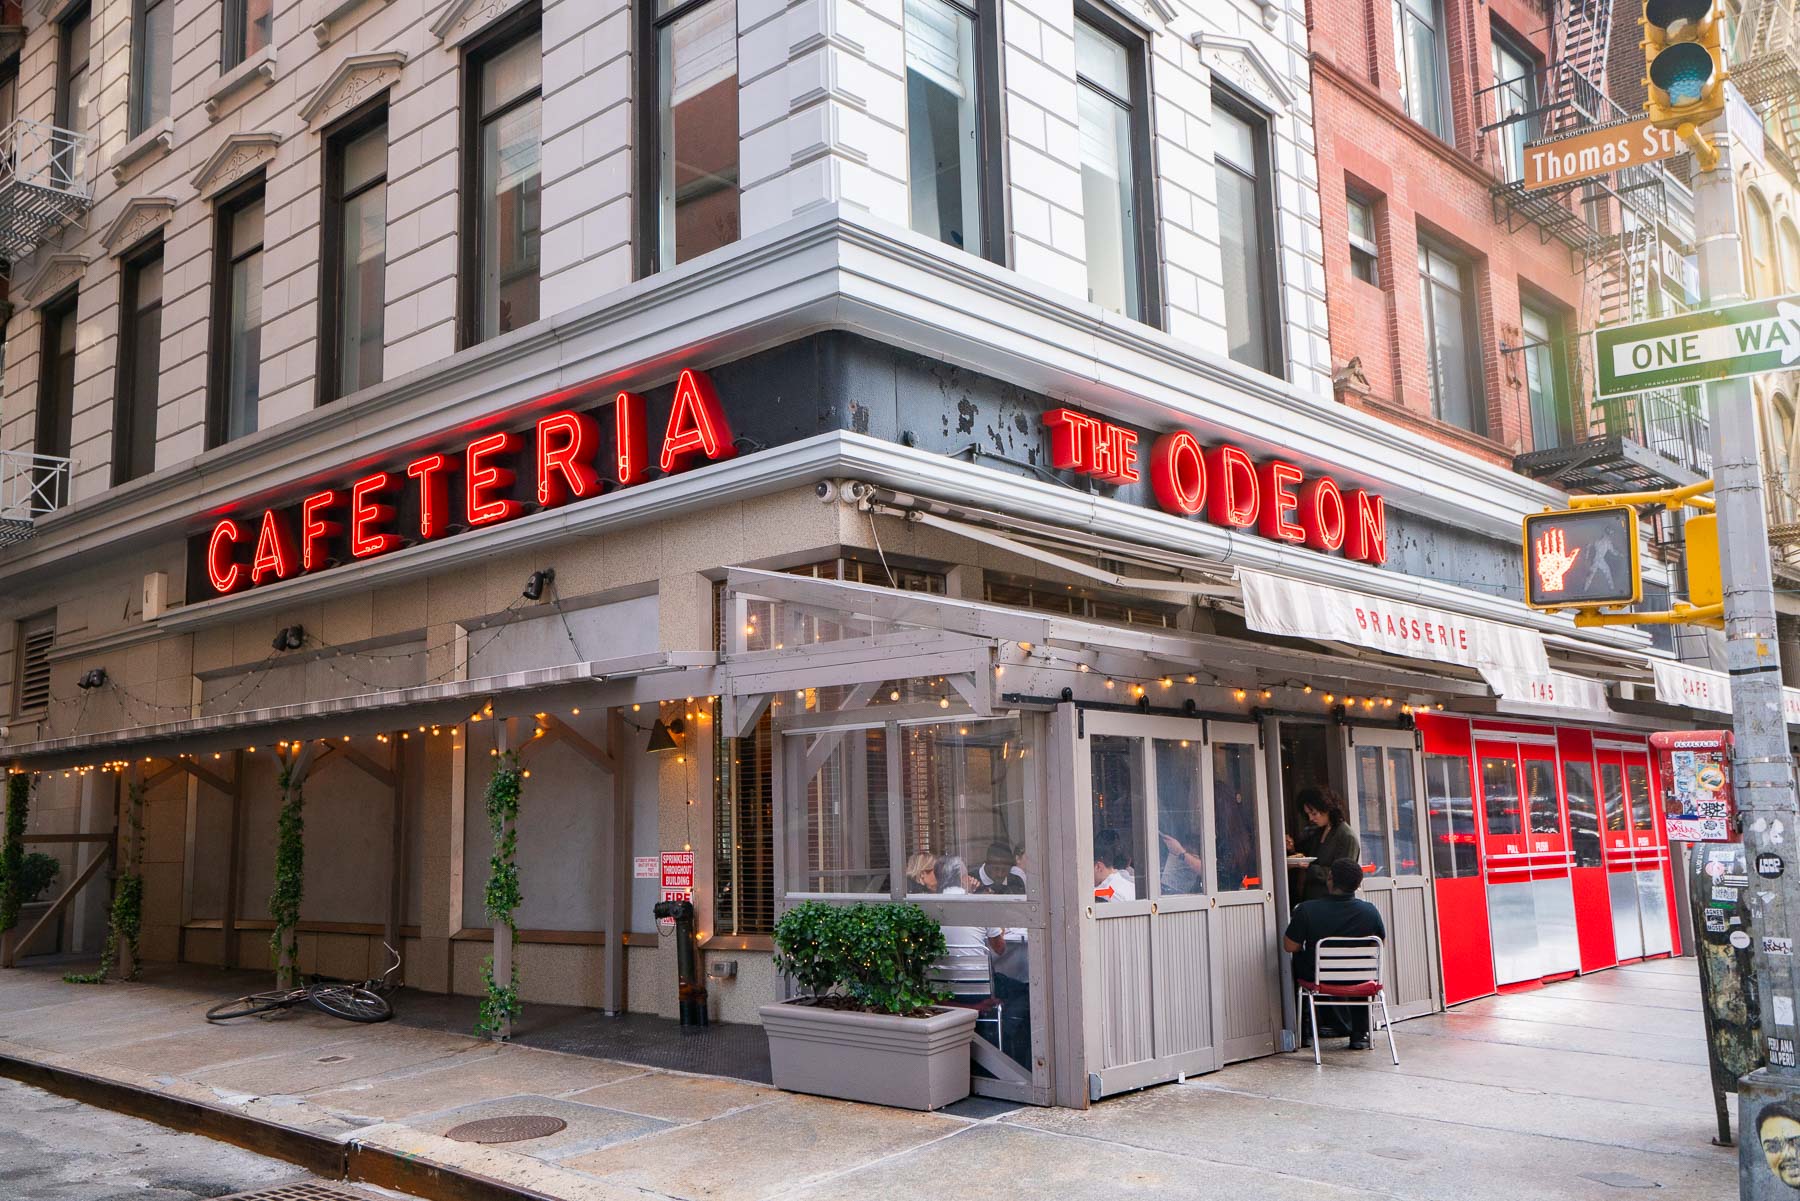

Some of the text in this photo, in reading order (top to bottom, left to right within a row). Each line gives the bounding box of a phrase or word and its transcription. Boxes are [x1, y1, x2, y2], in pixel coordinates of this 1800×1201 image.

[1531, 111, 1650, 148] TRIBECA SOUTH HISTORIC DIST
[1532, 125, 1671, 183] Thomas St
[1632, 334, 1701, 370] ONE
[1645, 375, 1701, 387] TRANSPORTATION
[207, 367, 738, 593] CAFETERIA
[1043, 407, 1388, 566] THE ODEON
[1354, 607, 1469, 650] BRASSERIE
[1531, 681, 1555, 701] 145
[1682, 675, 1708, 698] CAFE
[1506, 844, 1520, 854] PULL
[1535, 841, 1549, 852] PUSH
[662, 854, 693, 864] SPRINKLERS
[663, 865, 692, 875] THROUGHOUT
[665, 876, 690, 886] BUILDING
[1780, 1039, 1794, 1053] ANA
[1778, 1052, 1795, 1067] PERU
